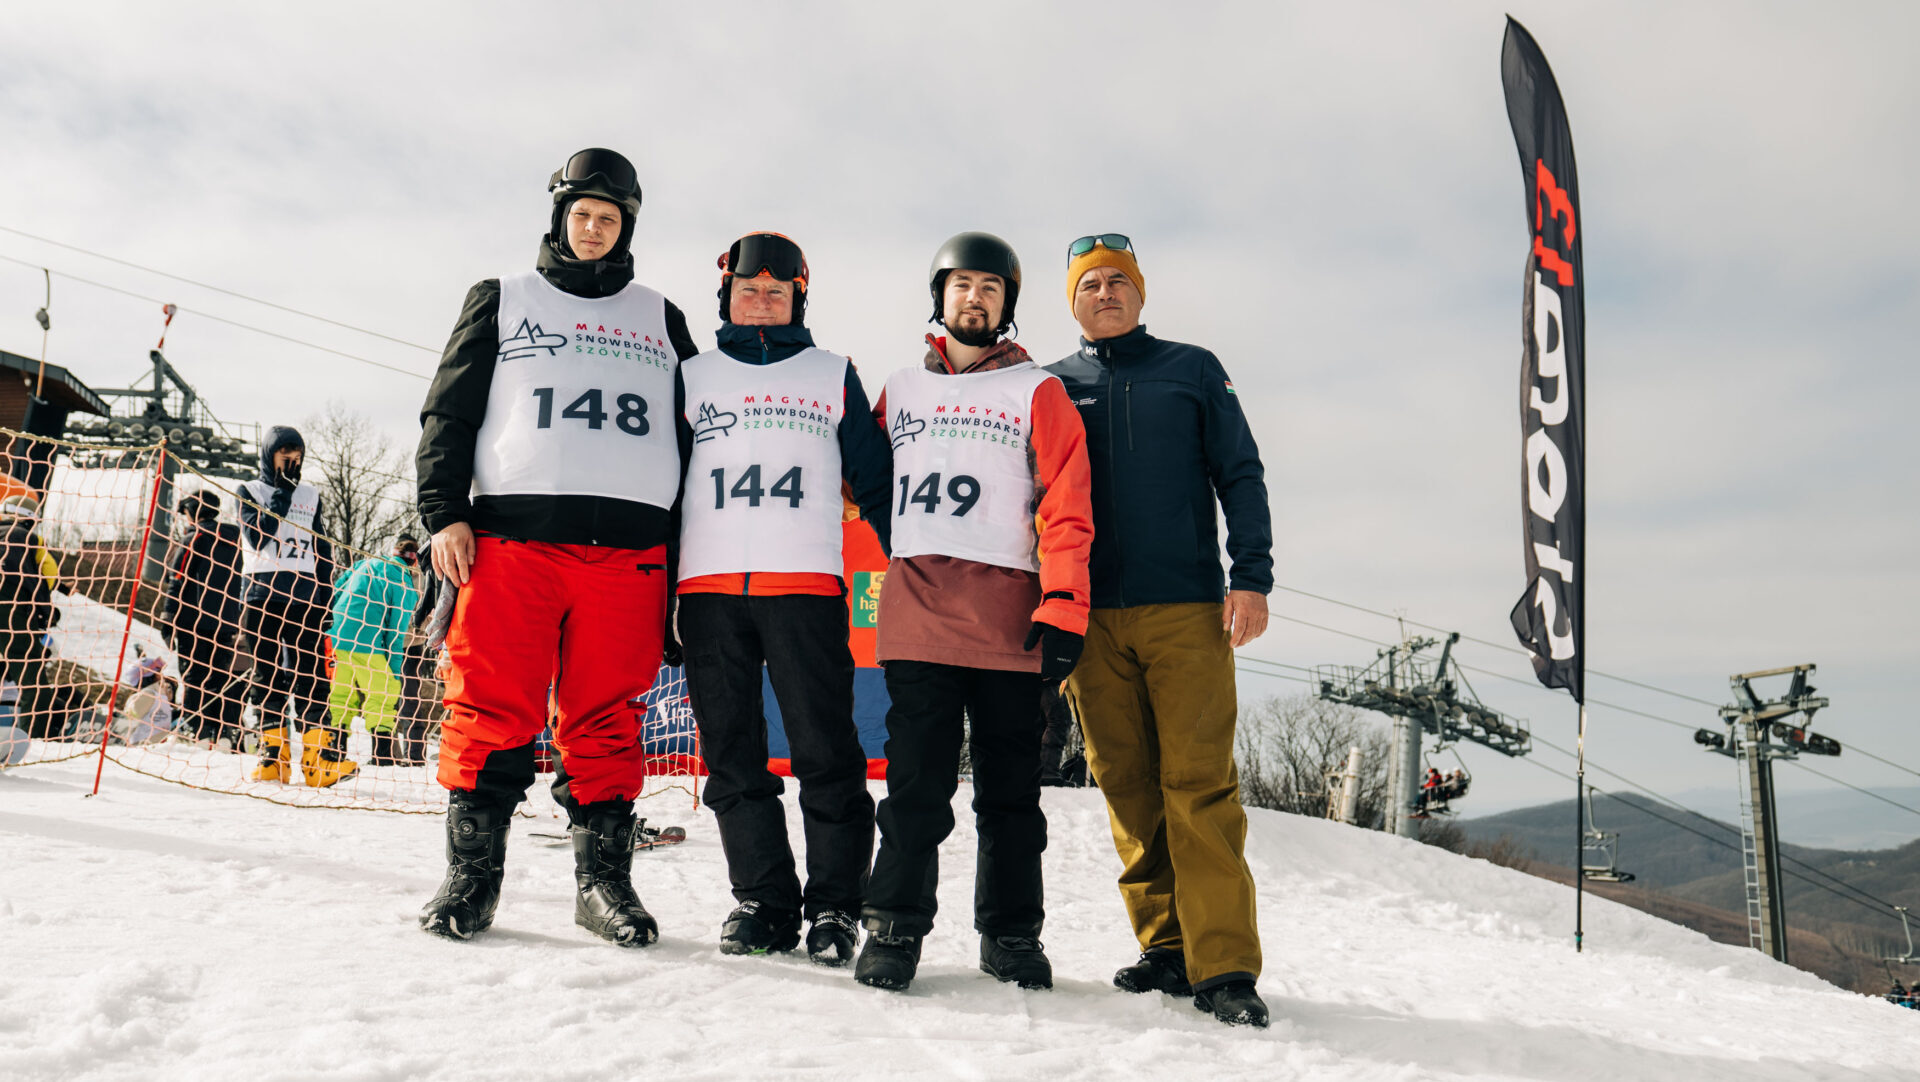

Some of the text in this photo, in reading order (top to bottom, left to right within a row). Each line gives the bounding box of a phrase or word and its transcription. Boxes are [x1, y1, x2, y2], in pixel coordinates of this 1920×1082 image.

[575, 323, 664, 348] MAGYAR
[575, 333, 667, 360] SNOWBOARD
[575, 345, 669, 371] SZÖVETSÉG
[532, 388, 650, 436] 148
[744, 395, 832, 414] MAGYAR
[936, 405, 1021, 425] MAGYAR
[744, 407, 829, 425] SNOWBOARD
[932, 416, 1021, 436] SNOWBOARD
[743, 420, 829, 438] SZÖVETSÉG
[930, 428, 1019, 449] SZÖVETSÉG
[711, 464, 804, 509] 144
[898, 472, 981, 517] 149
[273, 537, 310, 559] 127
